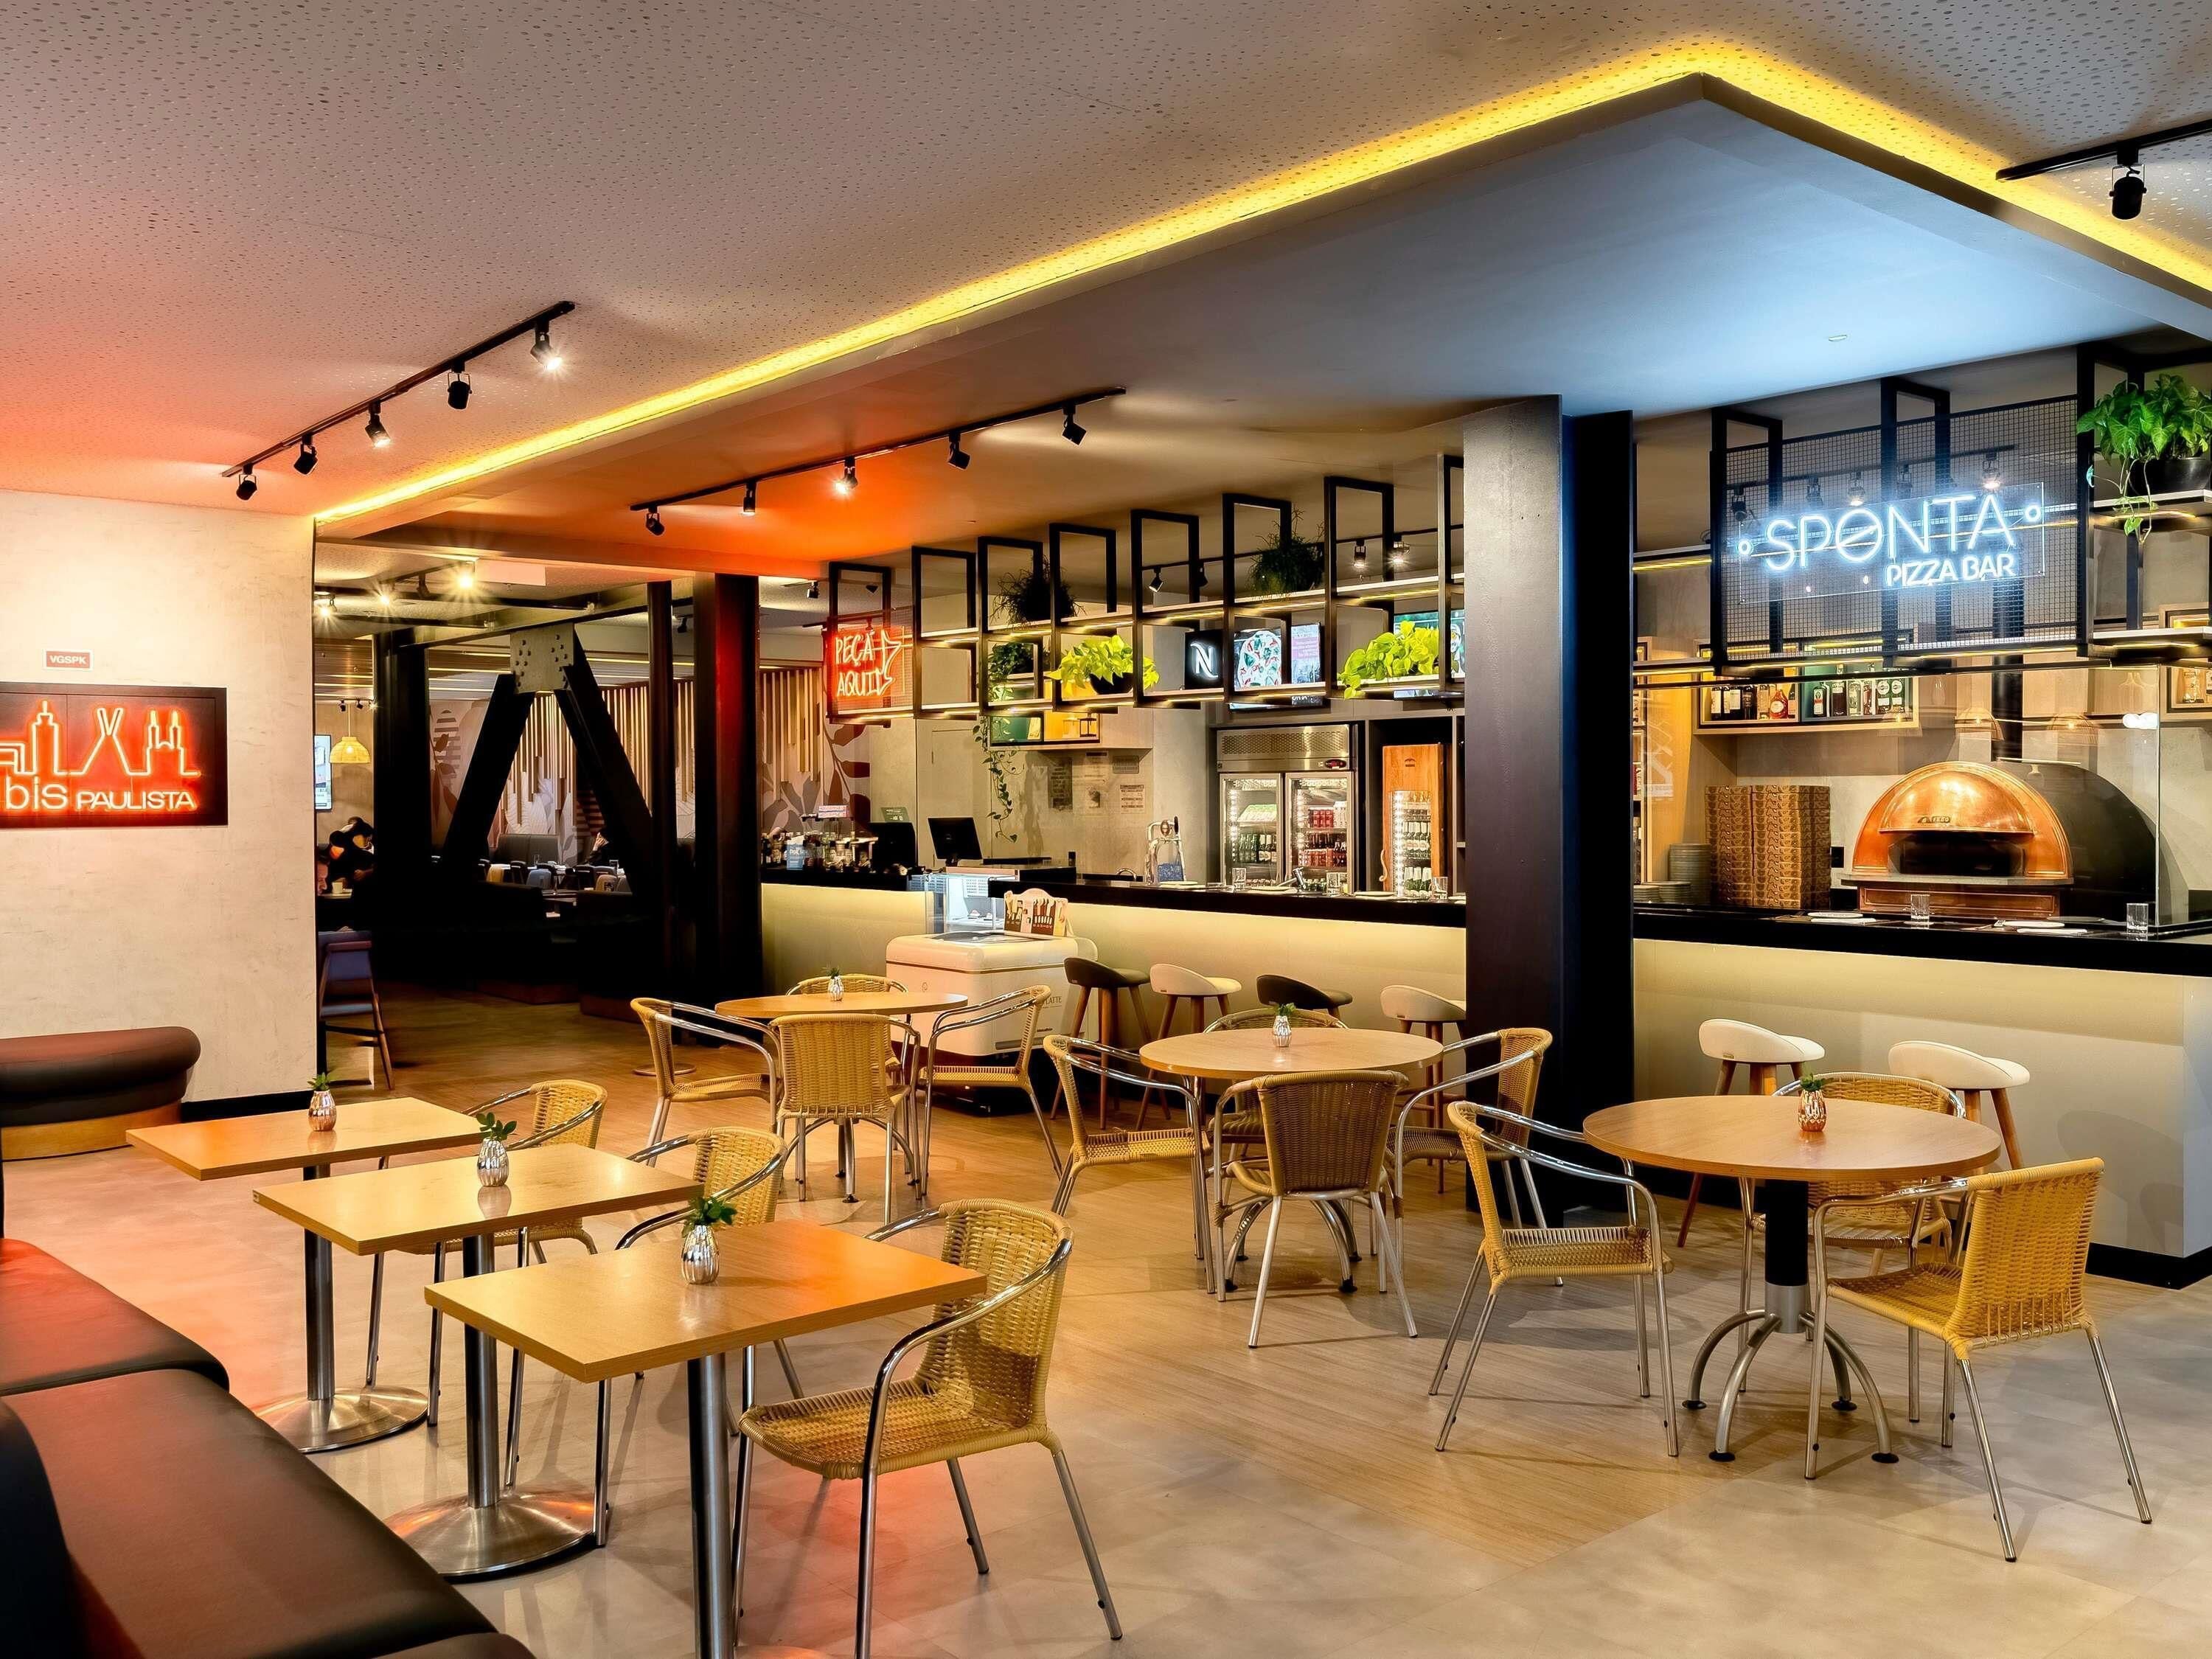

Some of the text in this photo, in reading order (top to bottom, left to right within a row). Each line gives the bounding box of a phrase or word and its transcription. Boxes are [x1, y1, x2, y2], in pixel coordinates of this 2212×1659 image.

[1885, 552, 2018, 587] PIZZA BAR
[49, 654, 86, 664] VGSPK
[836, 670, 877, 696] AQUI
[76, 790, 197, 810] PAULISTA
